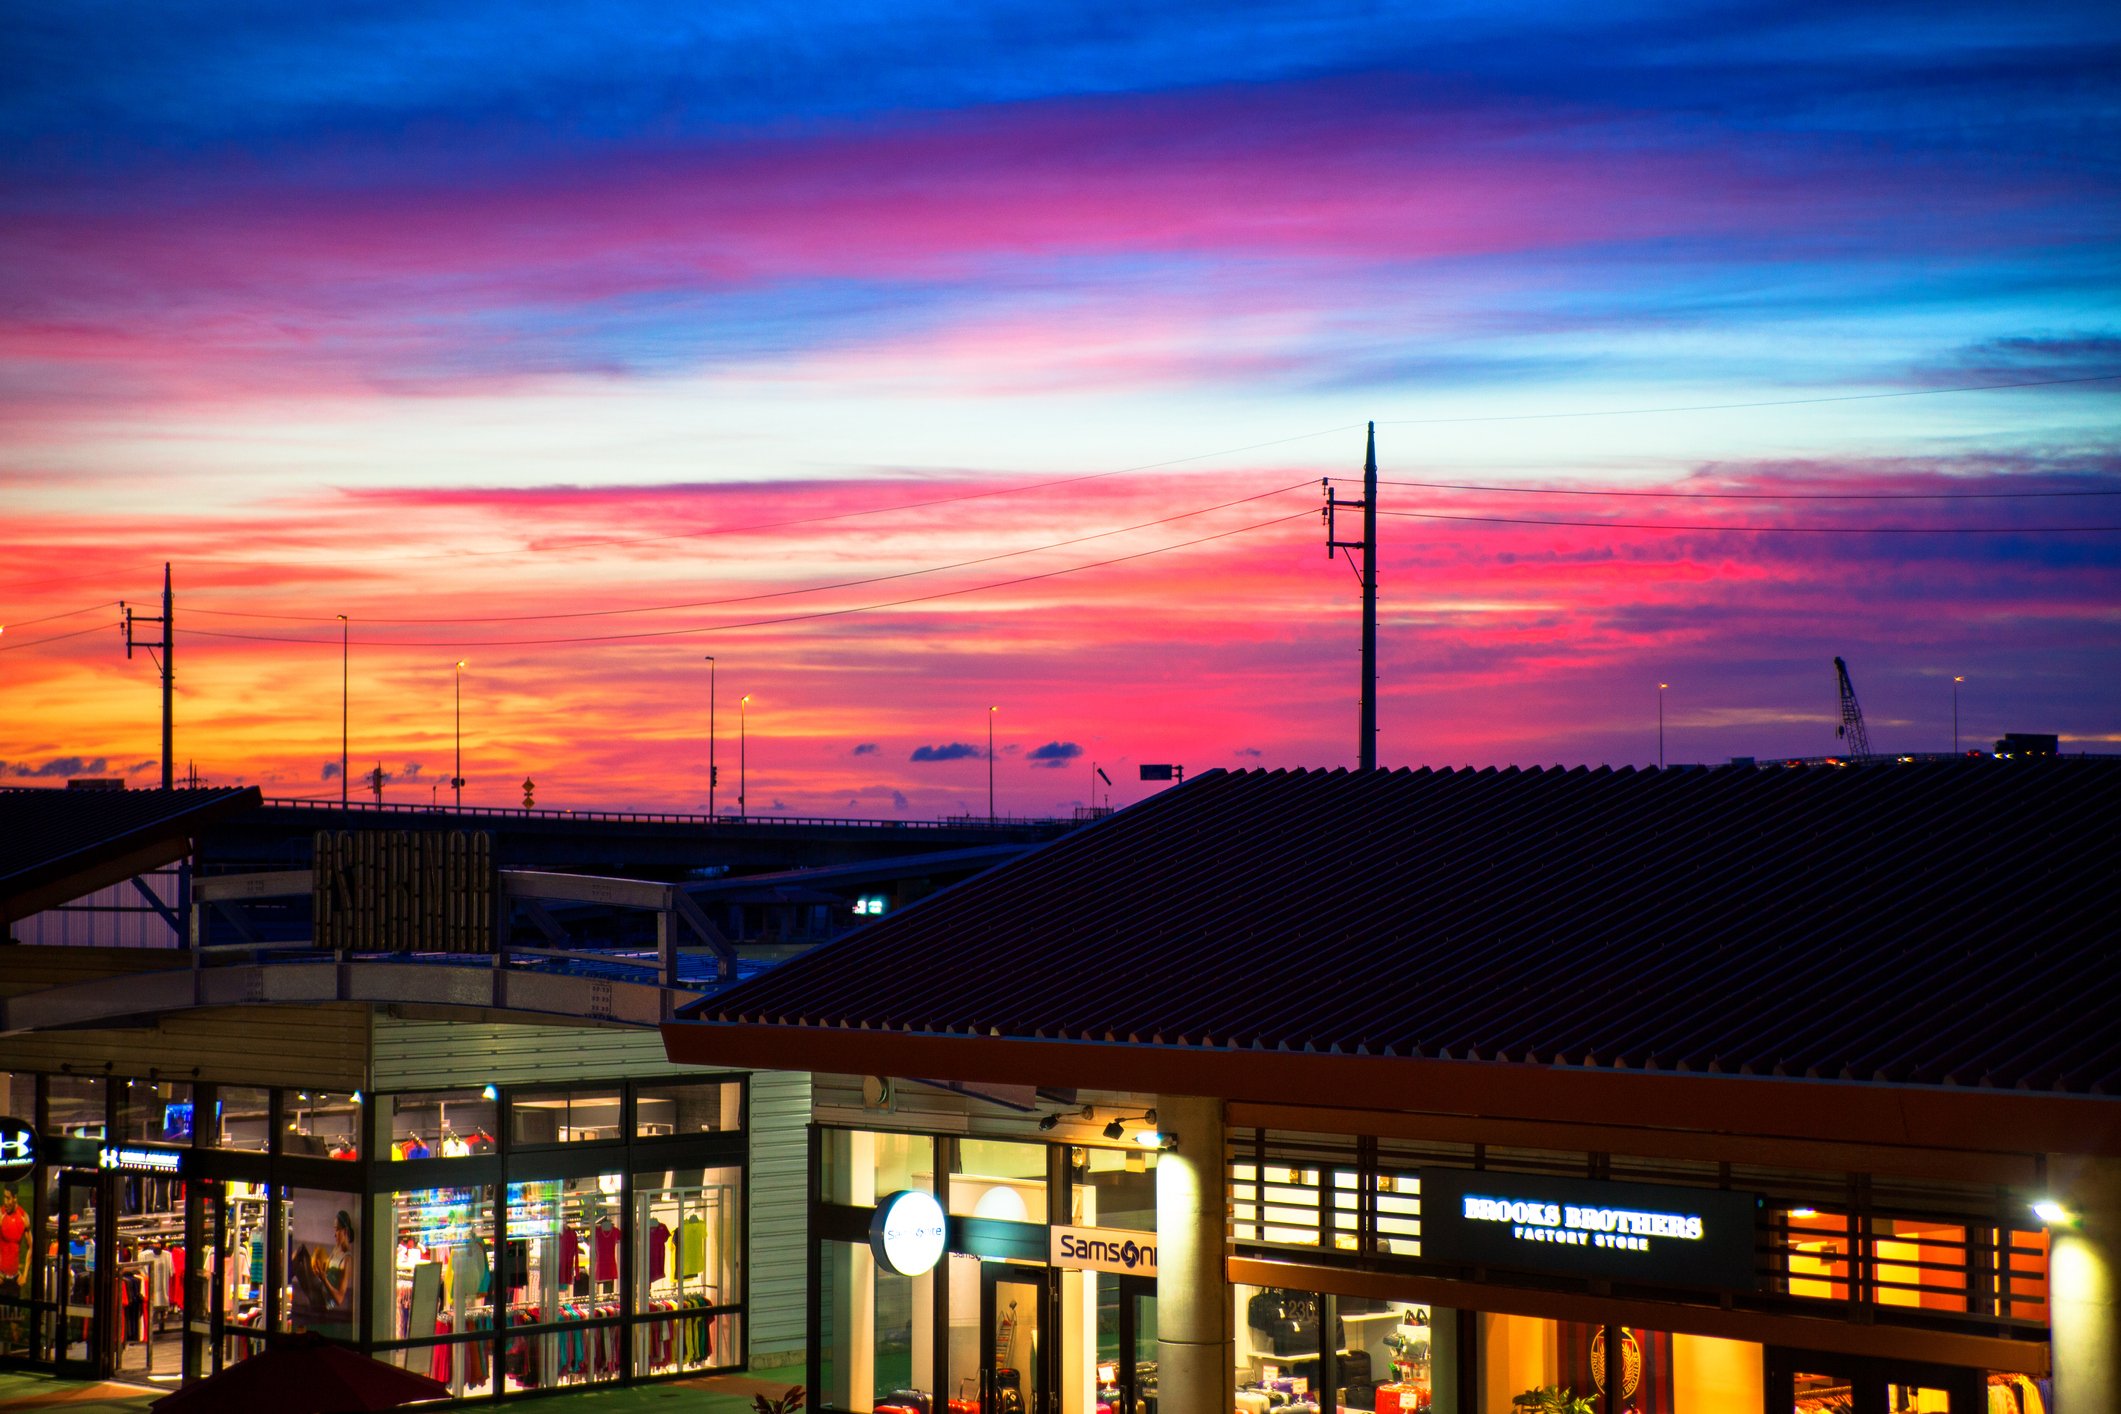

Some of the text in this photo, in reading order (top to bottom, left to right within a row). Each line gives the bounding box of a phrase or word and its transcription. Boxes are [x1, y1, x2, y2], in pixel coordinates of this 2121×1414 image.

[312, 829, 491, 952] ASHIBINAA
[1463, 1195, 1704, 1240] BROOKS BROTHERS
[1060, 1234, 1158, 1268] Samsoni
[1512, 1227, 1650, 1251] FACTORY STORE
